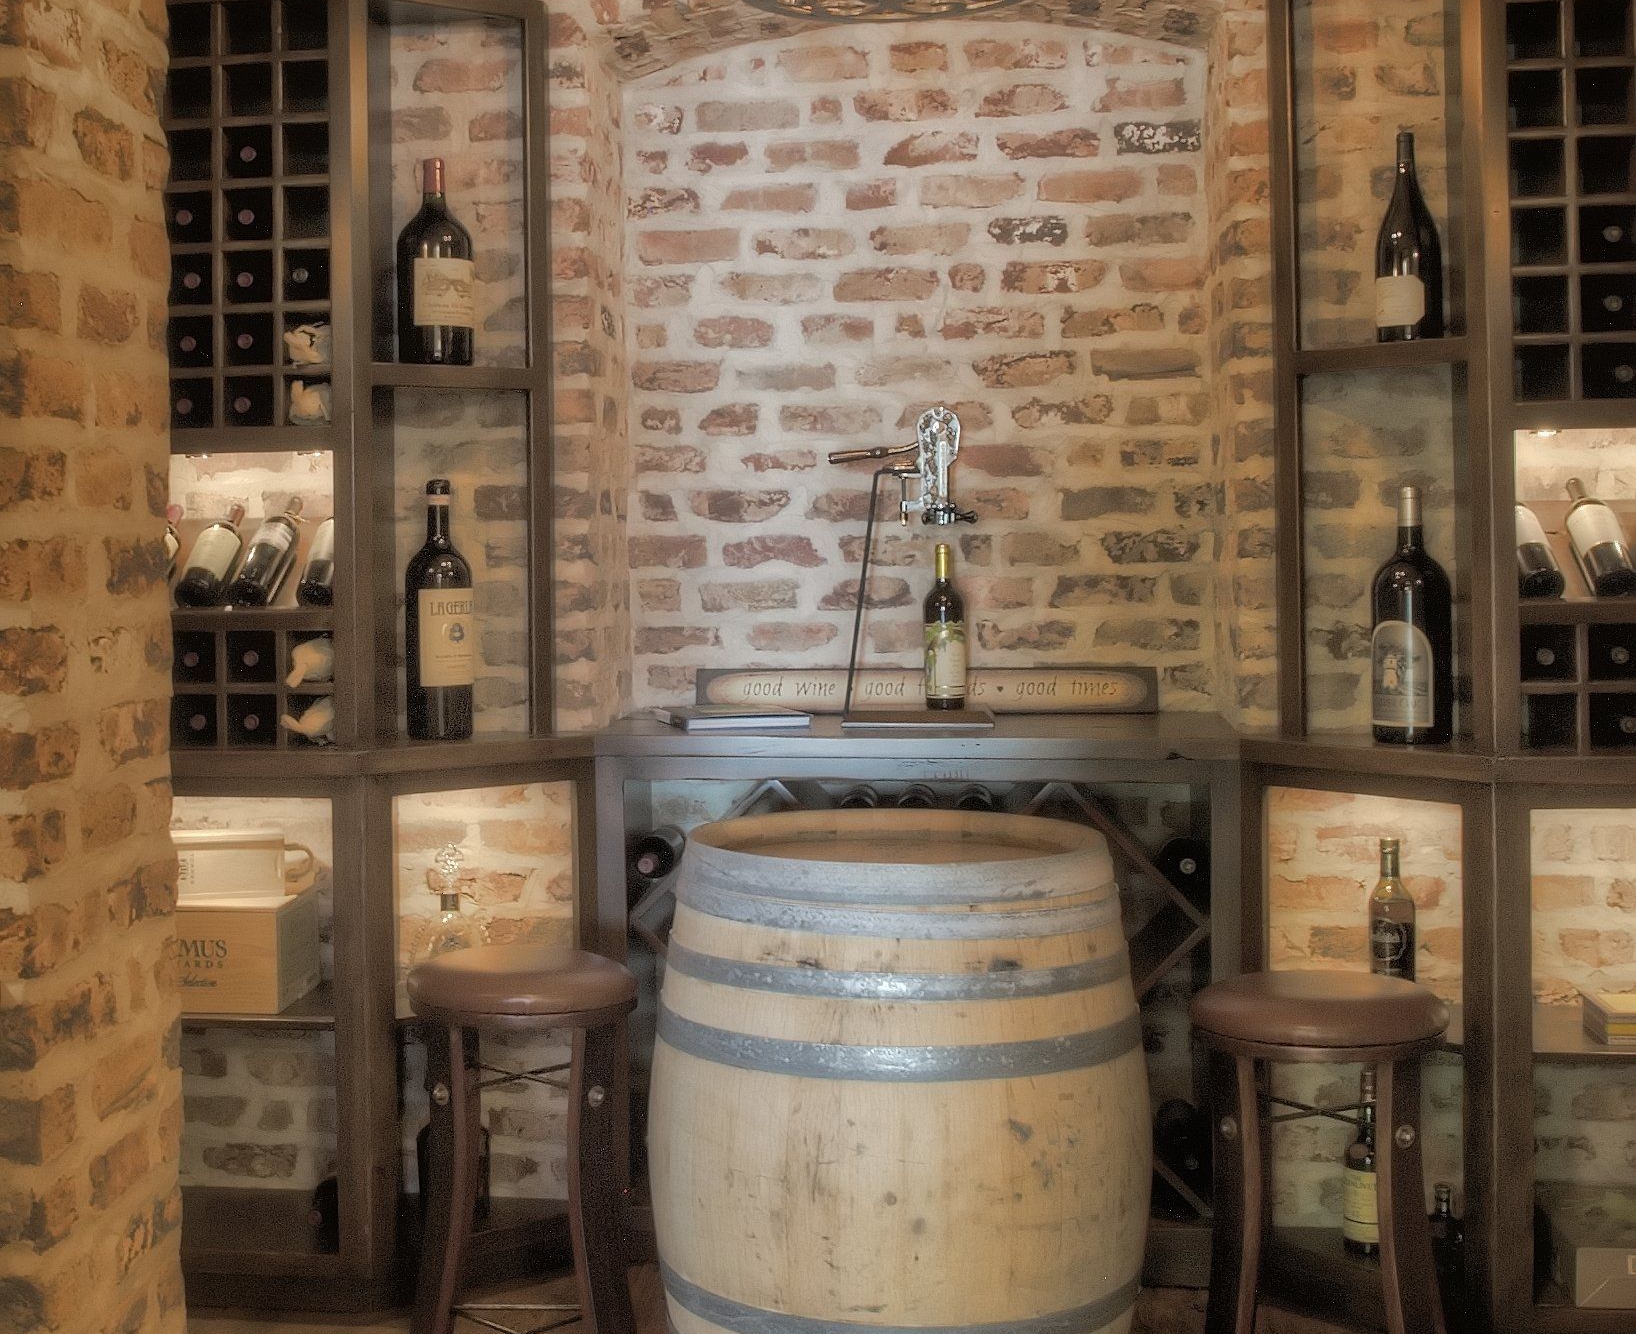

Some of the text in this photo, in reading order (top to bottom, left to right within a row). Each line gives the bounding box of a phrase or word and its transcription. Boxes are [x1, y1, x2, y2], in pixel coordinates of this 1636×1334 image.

[740, 675, 784, 702] good
[795, 676, 836, 697] wine
[860, 675, 906, 702] good
[1013, 675, 1058, 702] good
[1071, 677, 1119, 696] times
[178, 939, 228, 958] MUS
[184, 960, 225, 969] ARDS
